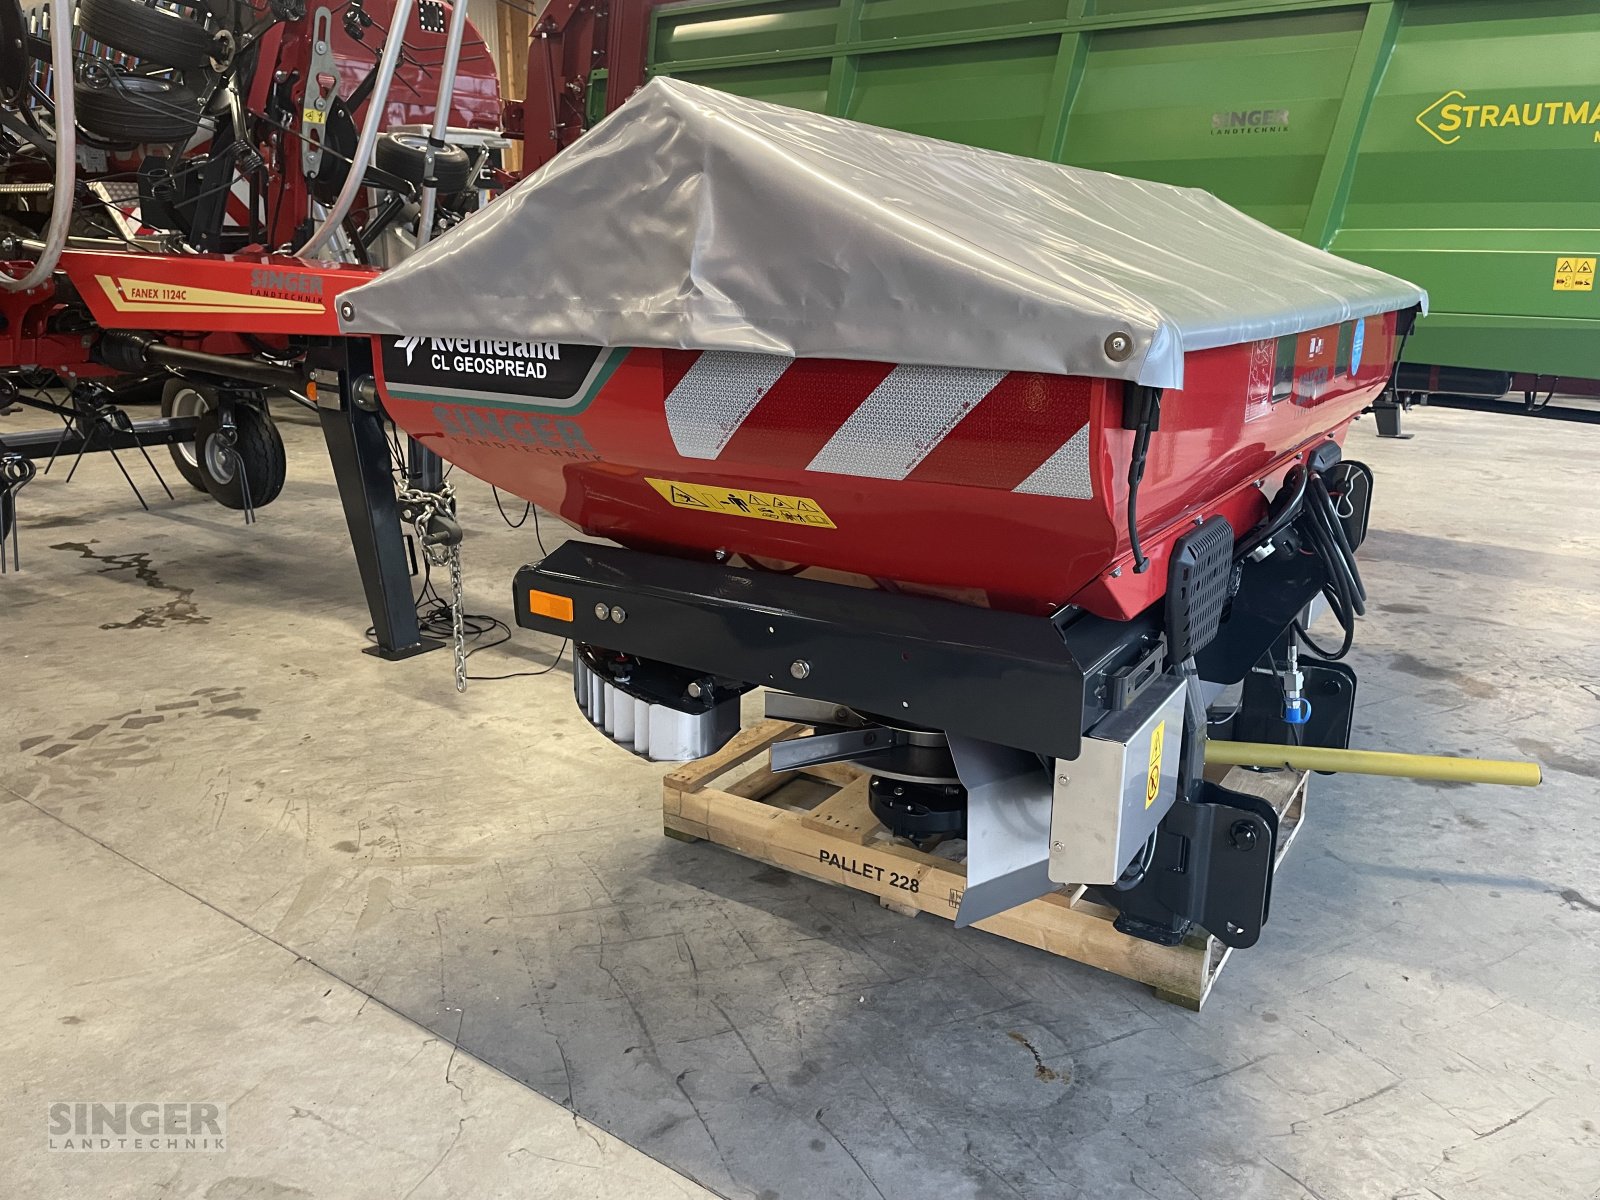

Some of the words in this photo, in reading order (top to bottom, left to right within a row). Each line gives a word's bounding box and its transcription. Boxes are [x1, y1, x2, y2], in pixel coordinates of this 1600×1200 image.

[1210, 126, 1289, 135] LANDTECHNIK
[131, 288, 159, 299] FANEX
[162, 289, 187, 300] 1124C
[251, 268, 323, 295] SINGER
[250, 288, 323, 304] LANDTECHNIK
[431, 354, 450, 371] CL
[453, 355, 547, 379] GEOSPREAD
[432, 406, 594, 451] SINGER
[451, 436, 604, 461] LANDTECHNIK
[819, 849, 884, 882] PALLET
[889, 872, 920, 893] 228
